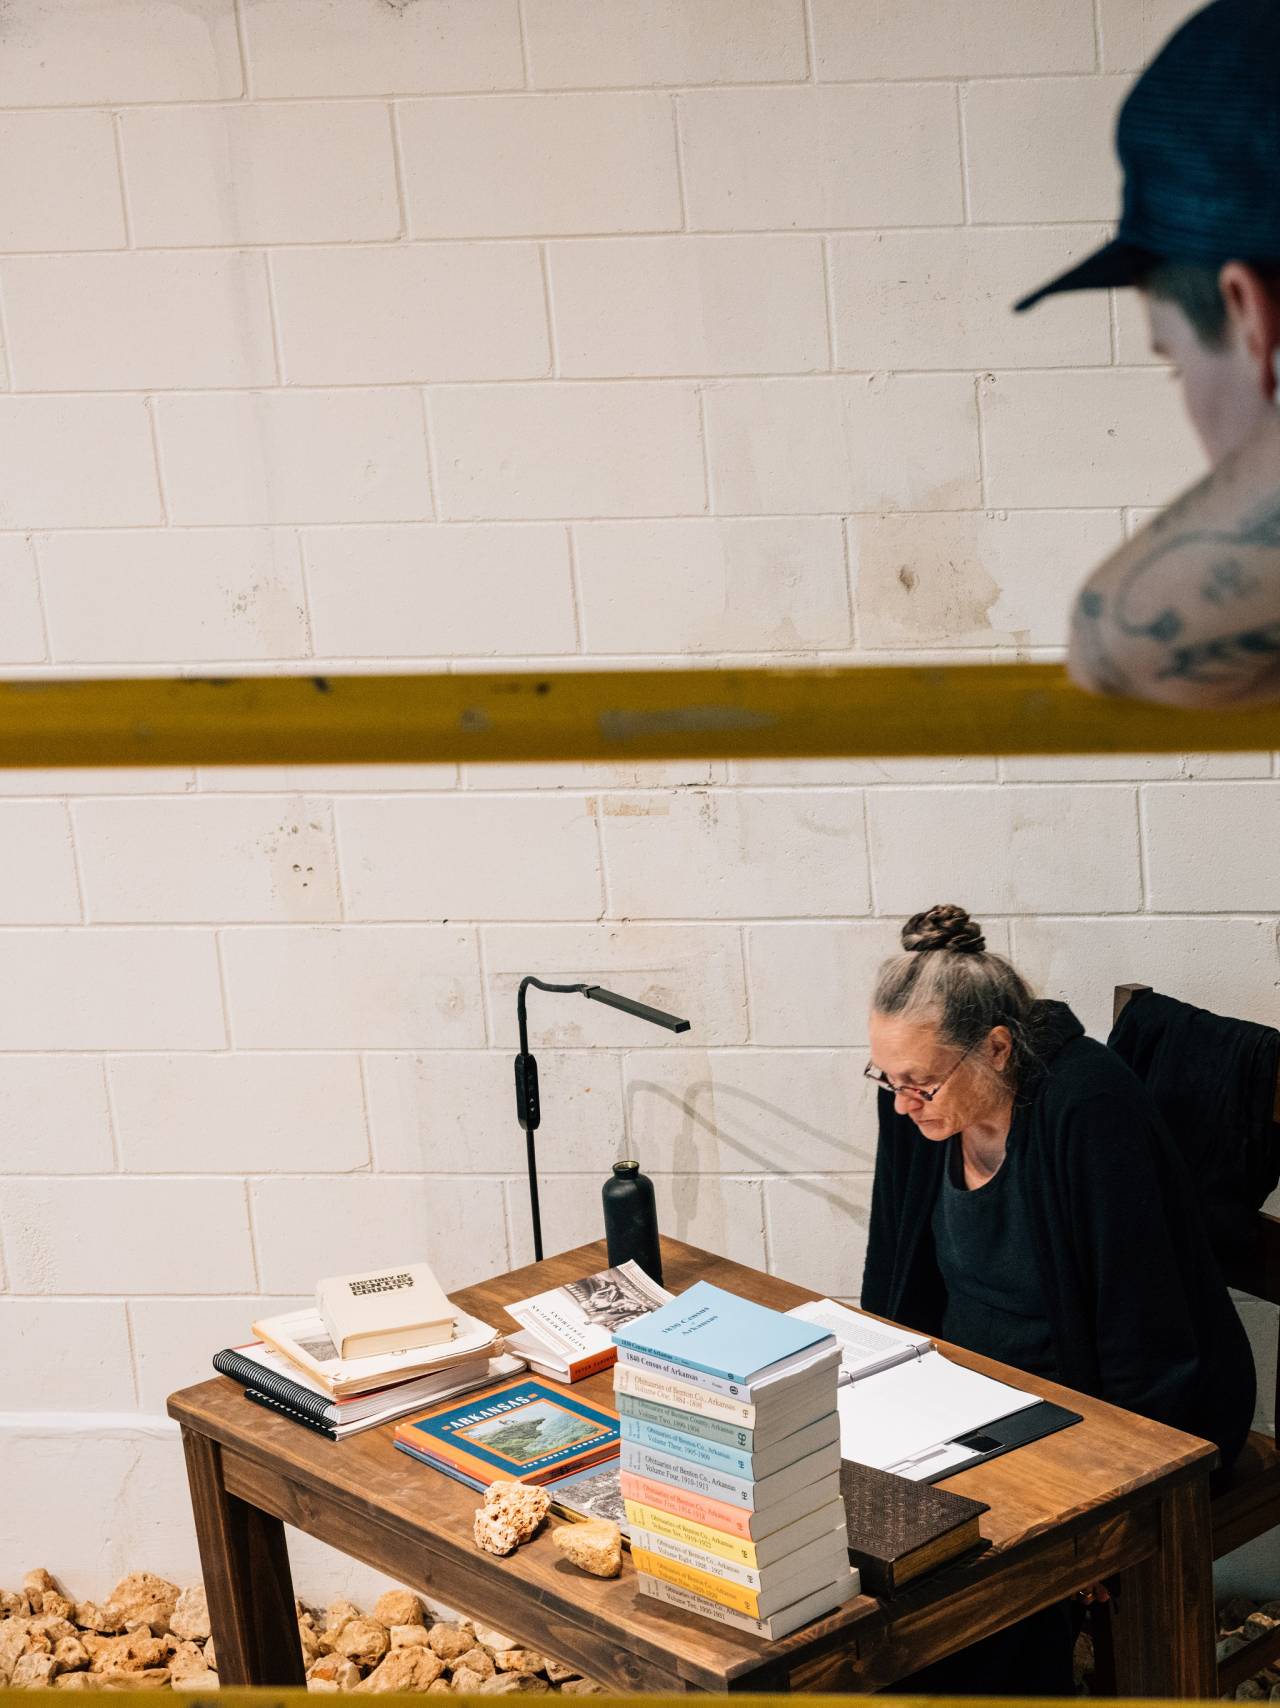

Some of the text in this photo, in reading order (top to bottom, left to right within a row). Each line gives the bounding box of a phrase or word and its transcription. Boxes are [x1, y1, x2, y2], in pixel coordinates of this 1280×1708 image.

[349, 1276, 394, 1286] HISTORY
[351, 1276, 414, 1291] BENTON
[352, 1282, 414, 1296] COUNTY
[532, 1304, 562, 1332] AMERICAN
[681, 1306, 710, 1324] Census
[682, 1316, 718, 1335] Arkansas
[640, 1359, 662, 1372] Census
[670, 1369, 698, 1381] Arkansas
[672, 1386, 694, 1399] Benton
[708, 1397, 736, 1410] Arkansas
[450, 1396, 530, 1430] ARKANSAS
[708, 1448, 730, 1460] Arkansas
[645, 1464, 666, 1478] Volume
[645, 1456, 672, 1470] Obituaries
[672, 1464, 680, 1472] of
[680, 1466, 699, 1479] Benton
[712, 1478, 736, 1492] Arkansas
